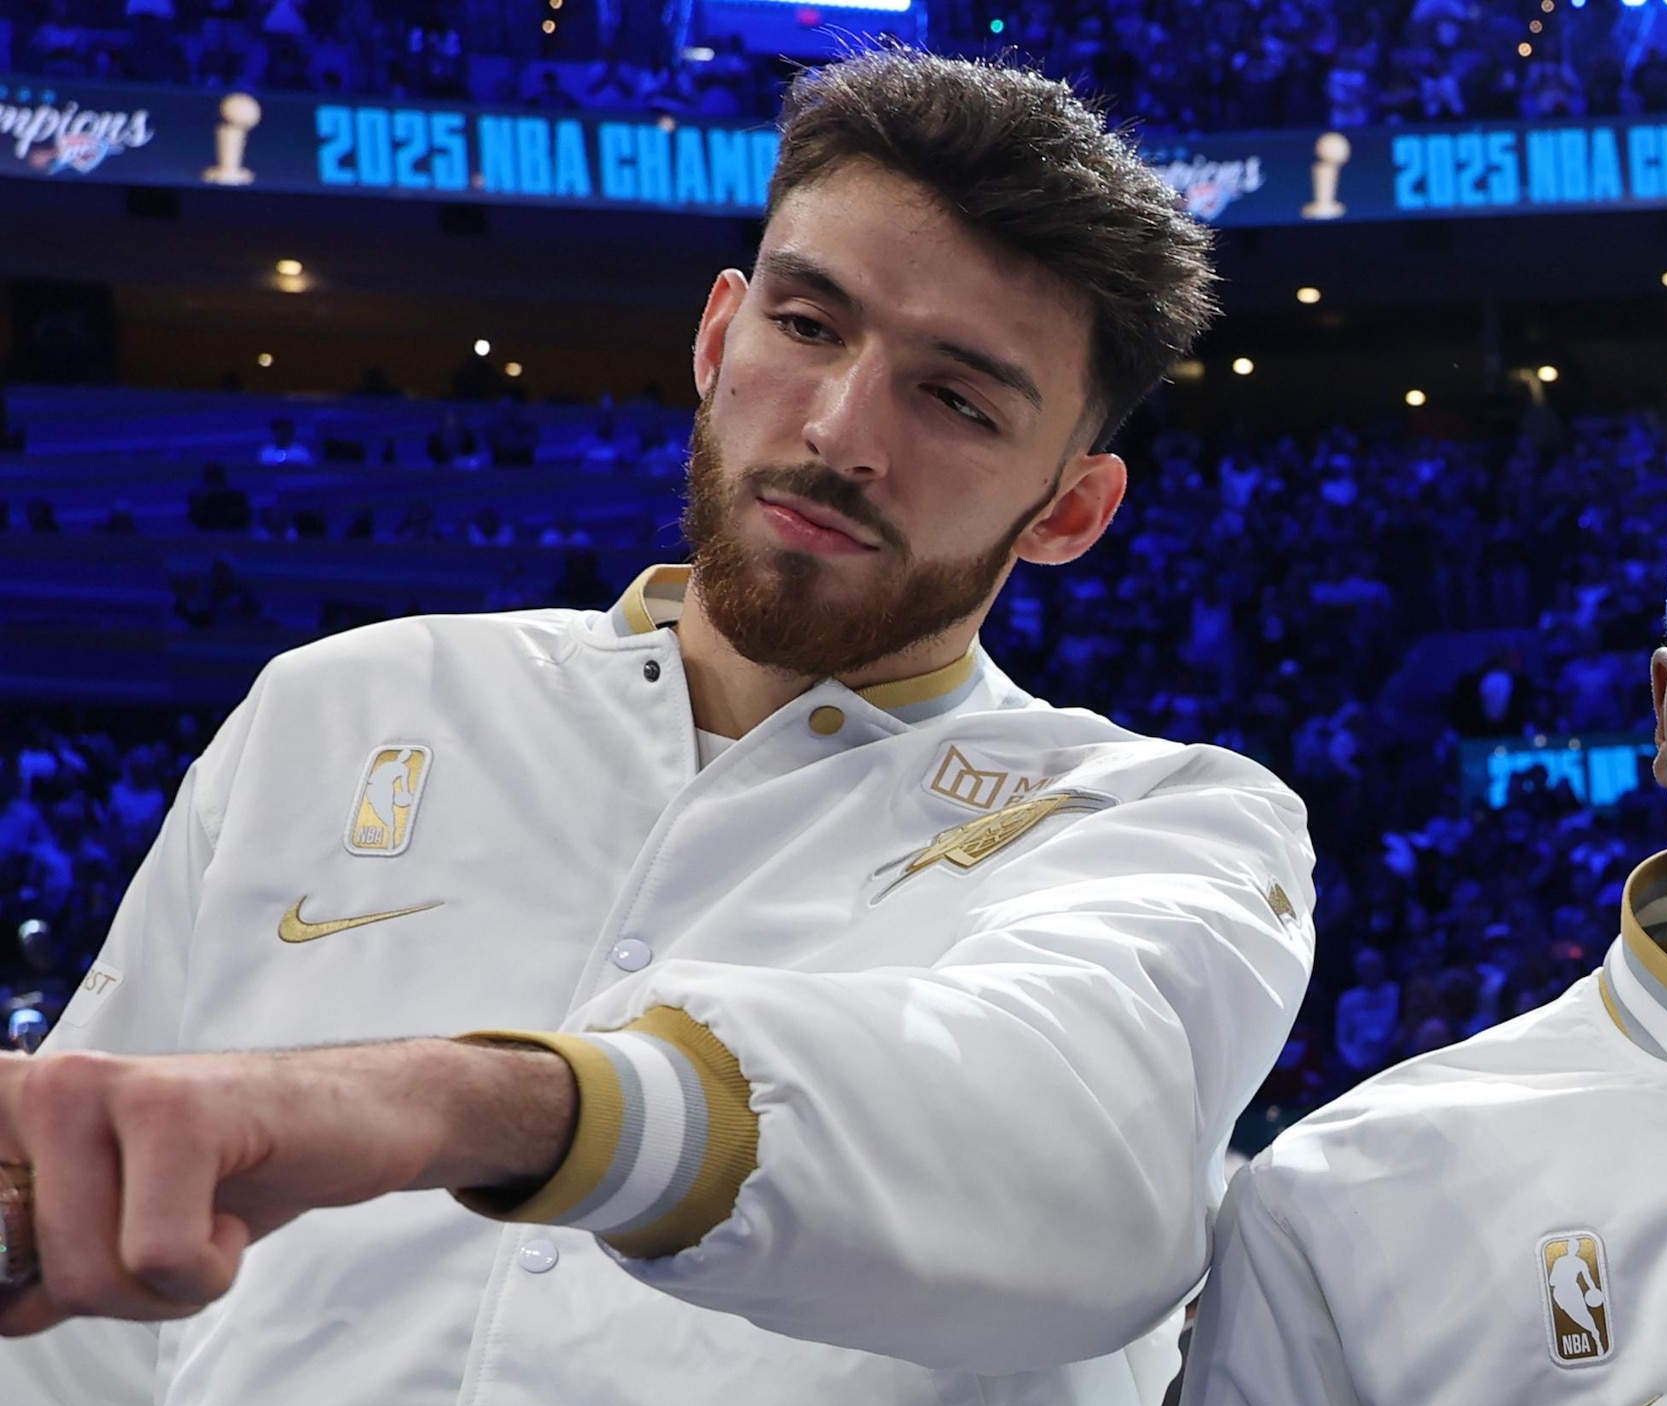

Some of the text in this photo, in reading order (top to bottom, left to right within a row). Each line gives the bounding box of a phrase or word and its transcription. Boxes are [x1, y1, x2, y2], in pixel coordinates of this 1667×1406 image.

[0, 100, 153, 159] mpions
[315, 105, 783, 207] 2025 NBA CHAMP
[1392, 130, 1521, 210] 2025
[1526, 128, 1625, 206] NBA
[360, 826, 383, 845] NBA
[1562, 1332, 1591, 1356] NBA
